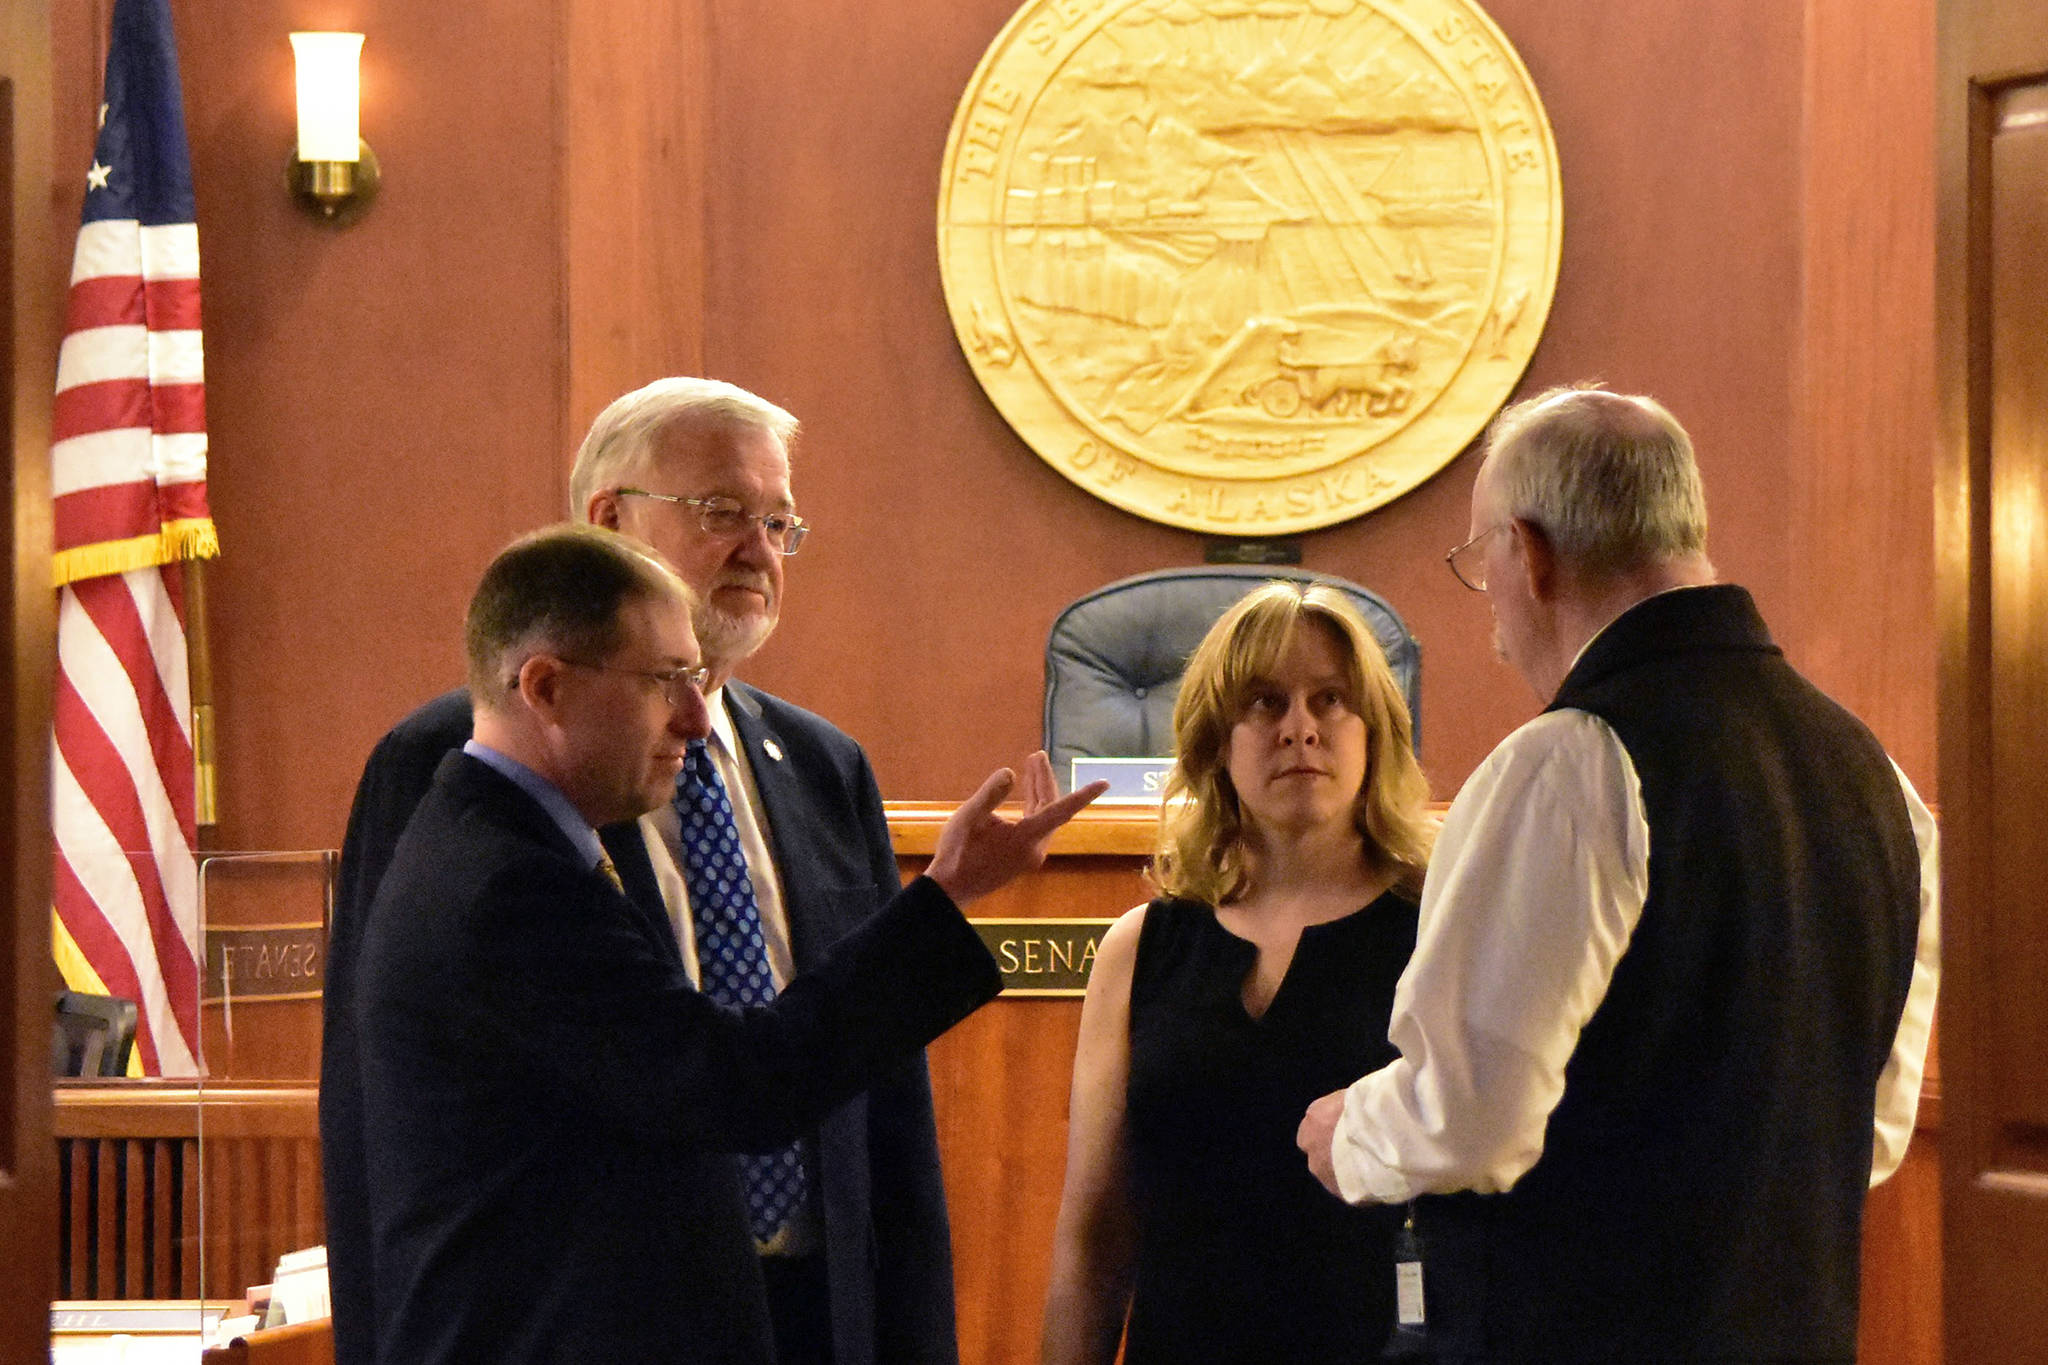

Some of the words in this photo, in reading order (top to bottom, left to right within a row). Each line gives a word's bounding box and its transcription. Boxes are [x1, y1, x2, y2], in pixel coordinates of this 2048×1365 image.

[959, 82, 1022, 183] THE
[1432, 14, 1539, 175] STATE
[1067, 441, 1136, 487] OF
[1165, 462, 1397, 522] ALASKA
